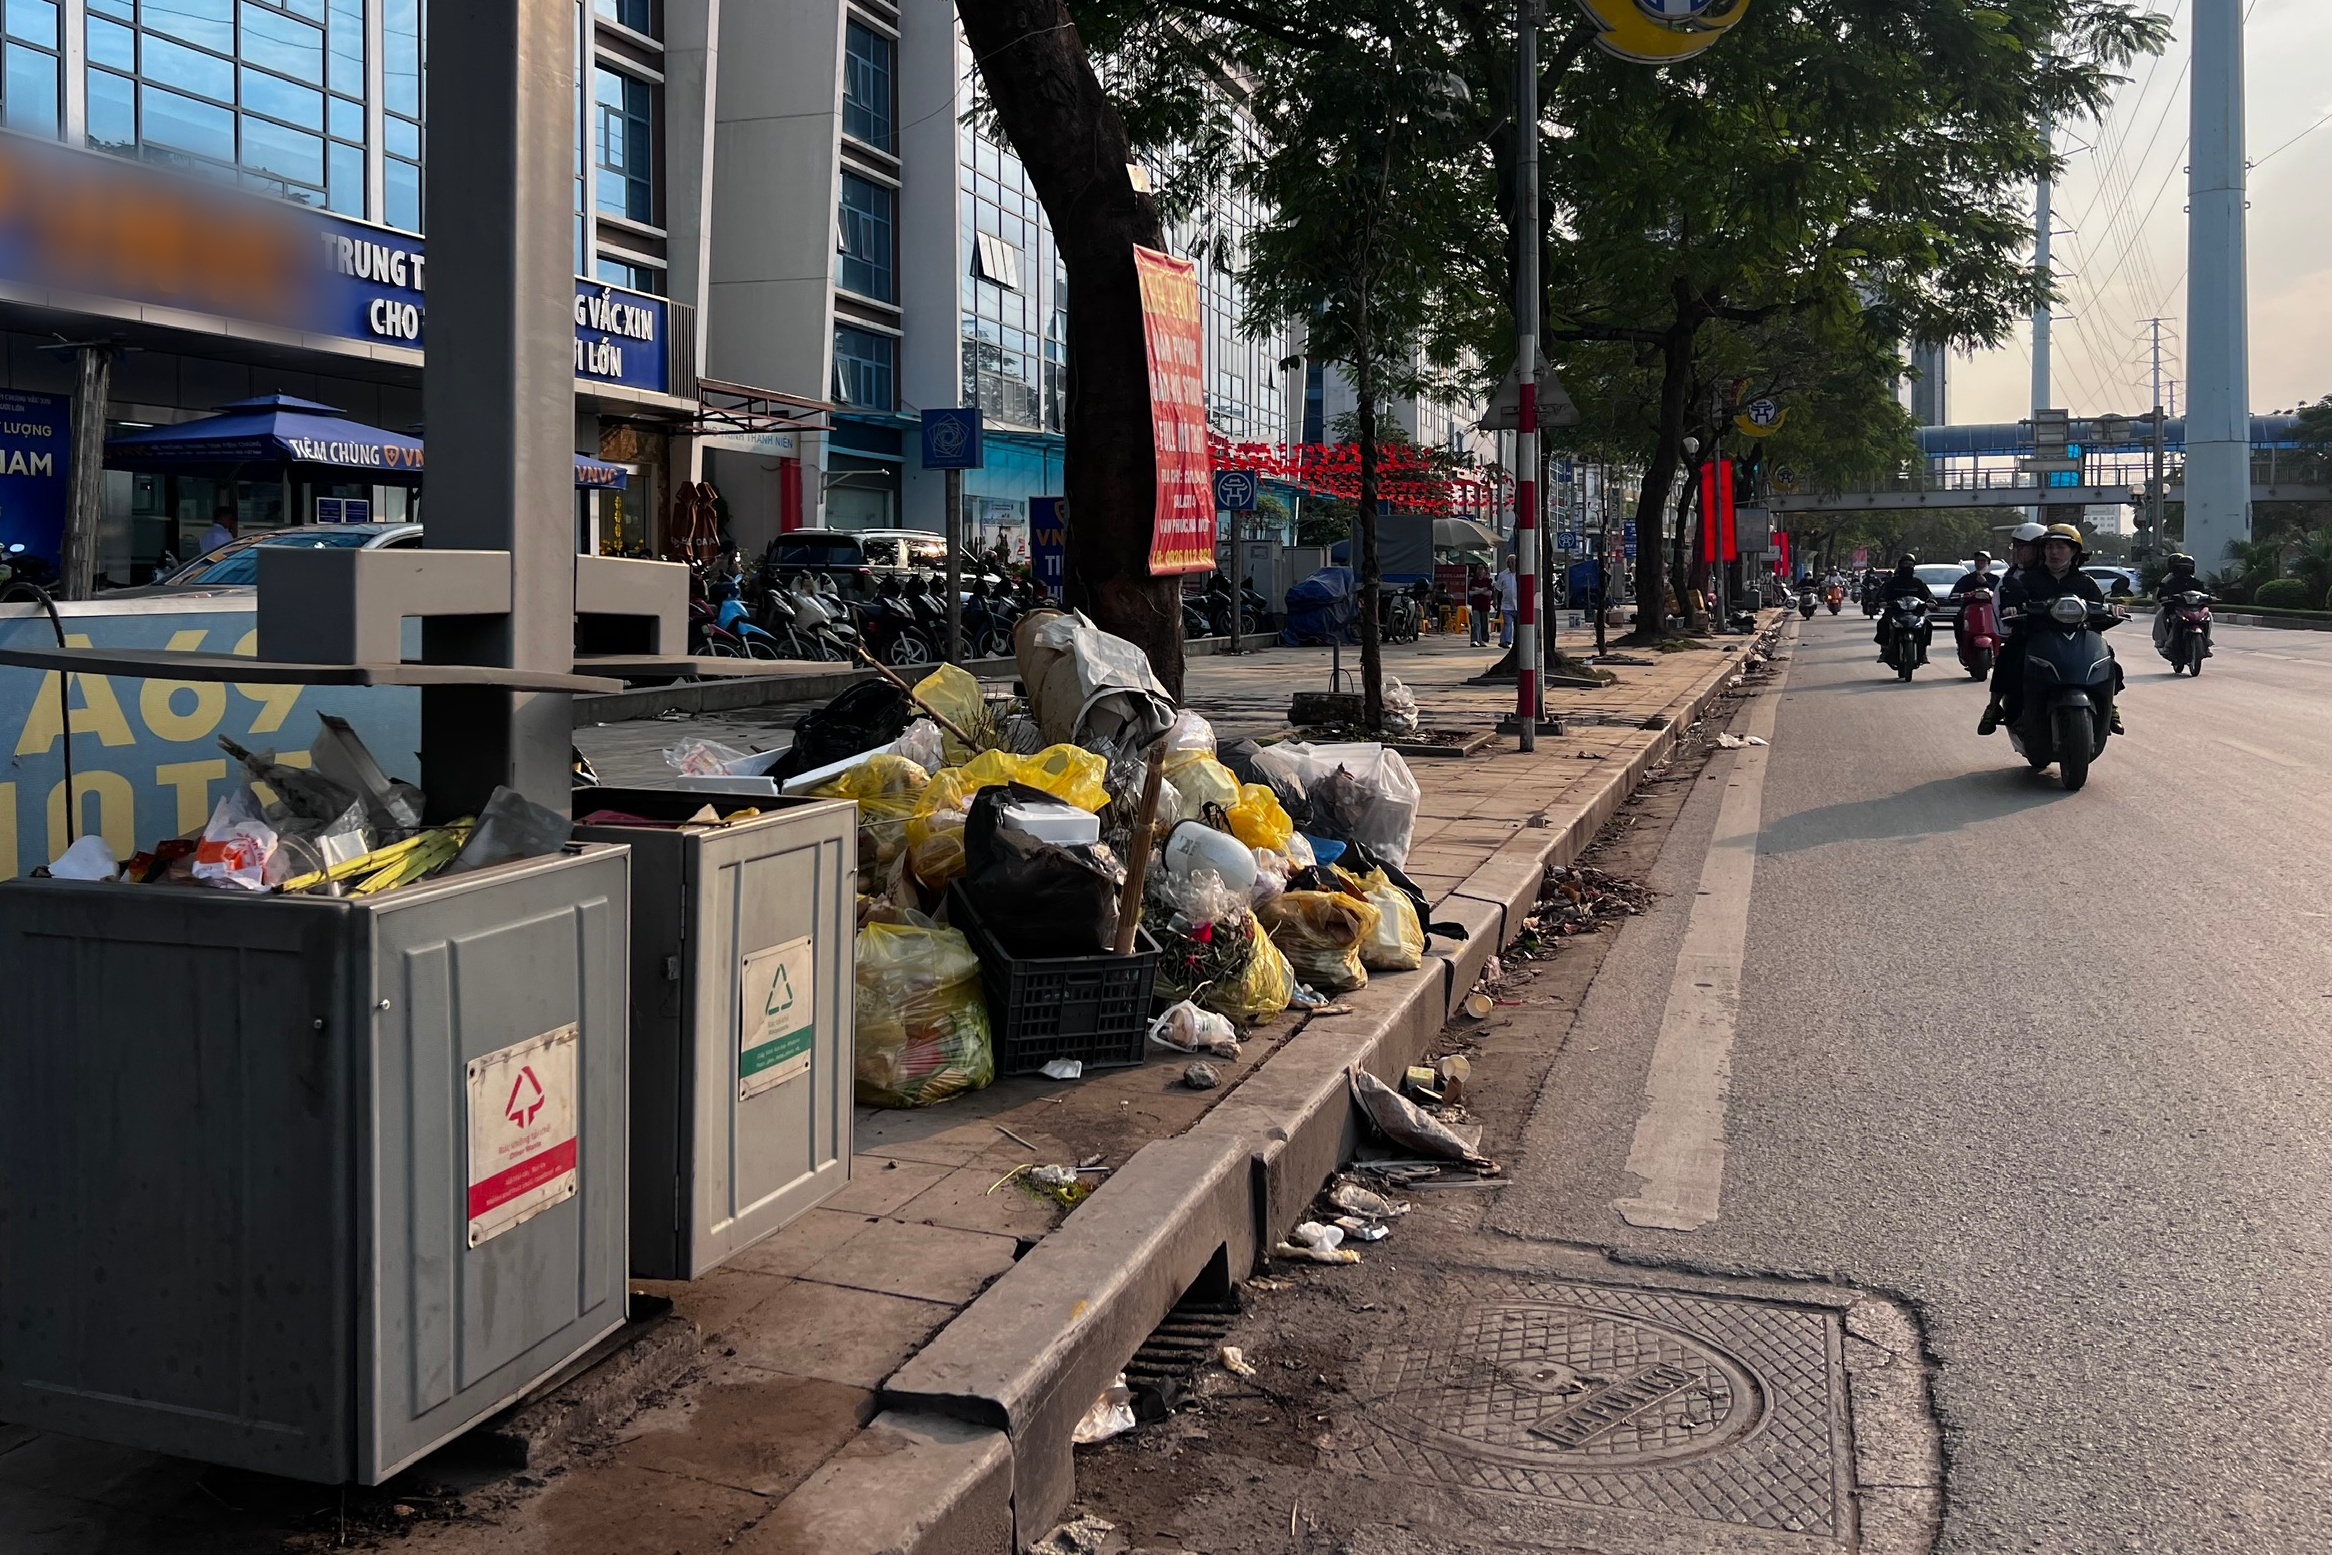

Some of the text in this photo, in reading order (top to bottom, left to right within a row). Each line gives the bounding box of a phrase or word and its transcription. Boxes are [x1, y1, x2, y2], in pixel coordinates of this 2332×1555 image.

[321, 231, 406, 287] TRUNG
[588, 287, 622, 335] VẮC
[624, 304, 653, 341] XIN
[370, 298, 419, 340] CHO
[588, 336, 622, 377] LỚN
[3, 421, 53, 439] LƯỢNG
[289, 437, 329, 462] TIÊM
[575, 464, 618, 485] VNVC
